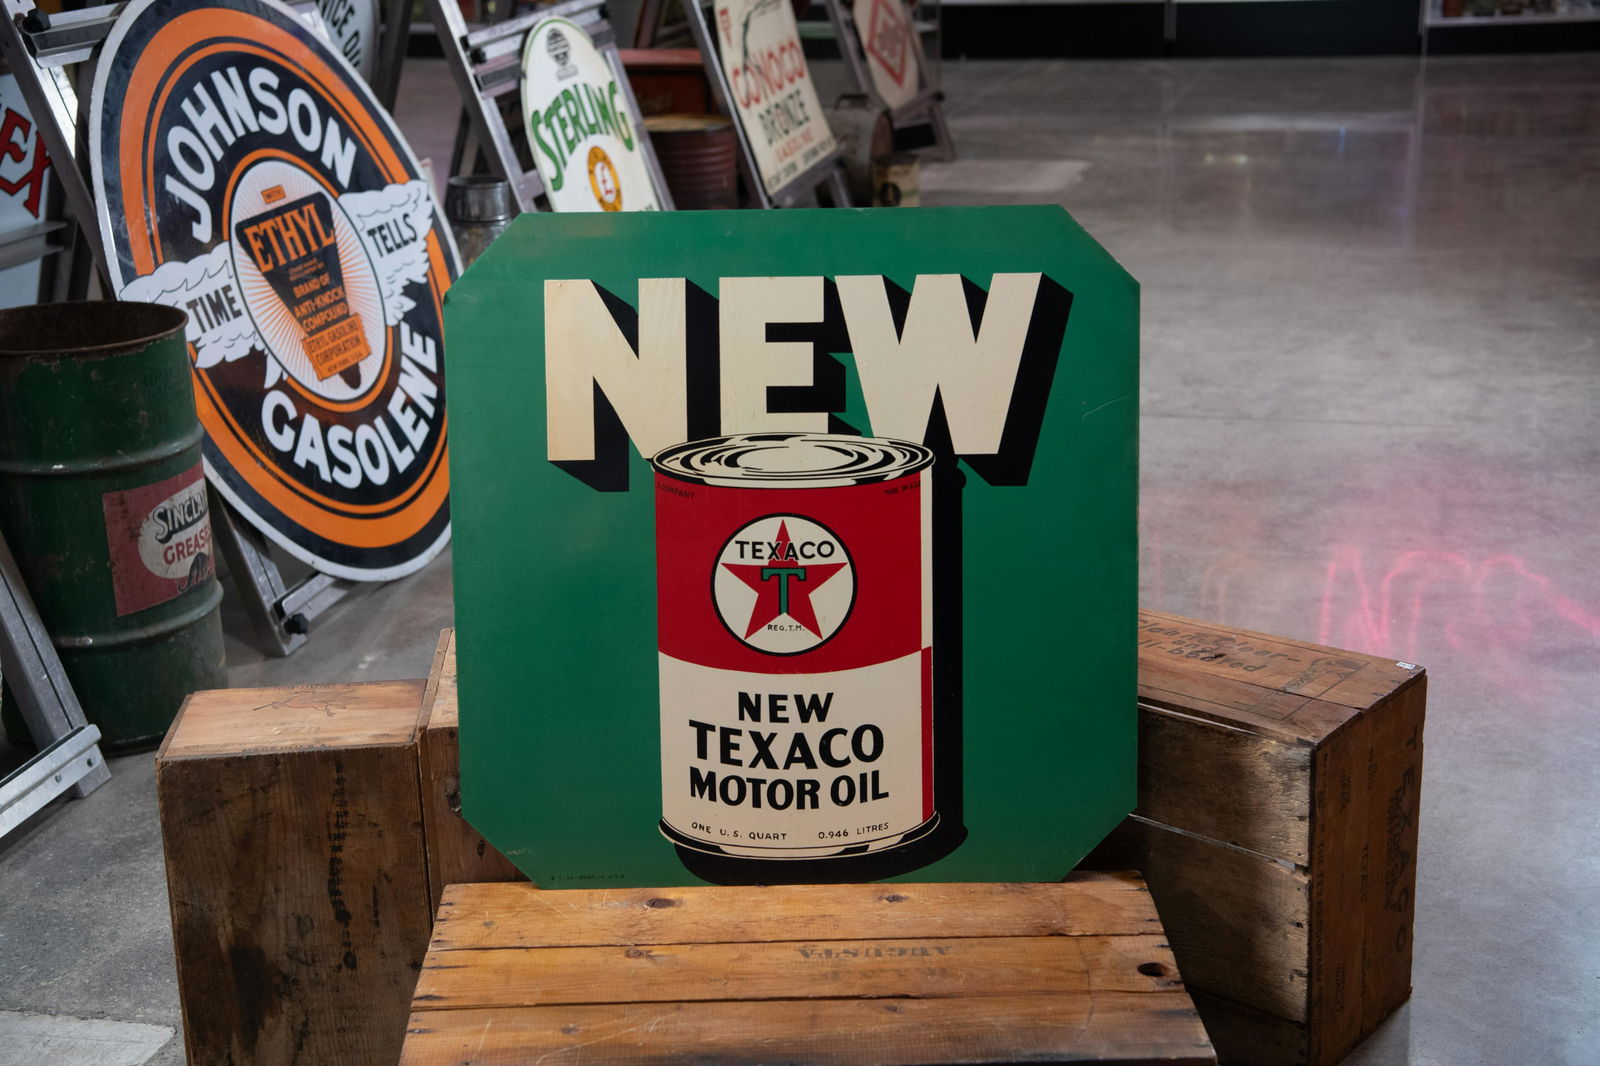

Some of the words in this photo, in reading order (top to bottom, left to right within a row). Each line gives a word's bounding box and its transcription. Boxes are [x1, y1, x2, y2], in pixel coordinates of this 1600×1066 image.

[165, 66, 357, 244] JOHNSON
[531, 80, 634, 192] STERLING
[244, 203, 336, 272] ETHYL
[367, 213, 417, 258] TELLS
[293, 277, 320, 298] BRAND
[319, 272, 330, 286] OF
[294, 286, 346, 318] ANTI-KNOCK
[185, 284, 242, 334] TIME
[302, 302, 348, 332] COMPOUND
[544, 272, 1043, 462] NEW
[261, 319, 438, 489] GASOLENE
[735, 540, 835, 561] TEXACO
[760, 567, 807, 616] T
[738, 691, 834, 723] NEW
[688, 719, 884, 770] TEXACO
[689, 766, 821, 811] MOTOR
[830, 769, 890, 807] OIL
[691, 821, 712, 834] ONE
[748, 831, 787, 841] QUART
[818, 829, 849, 840] 0.946
[856, 822, 890, 835] LITRES
